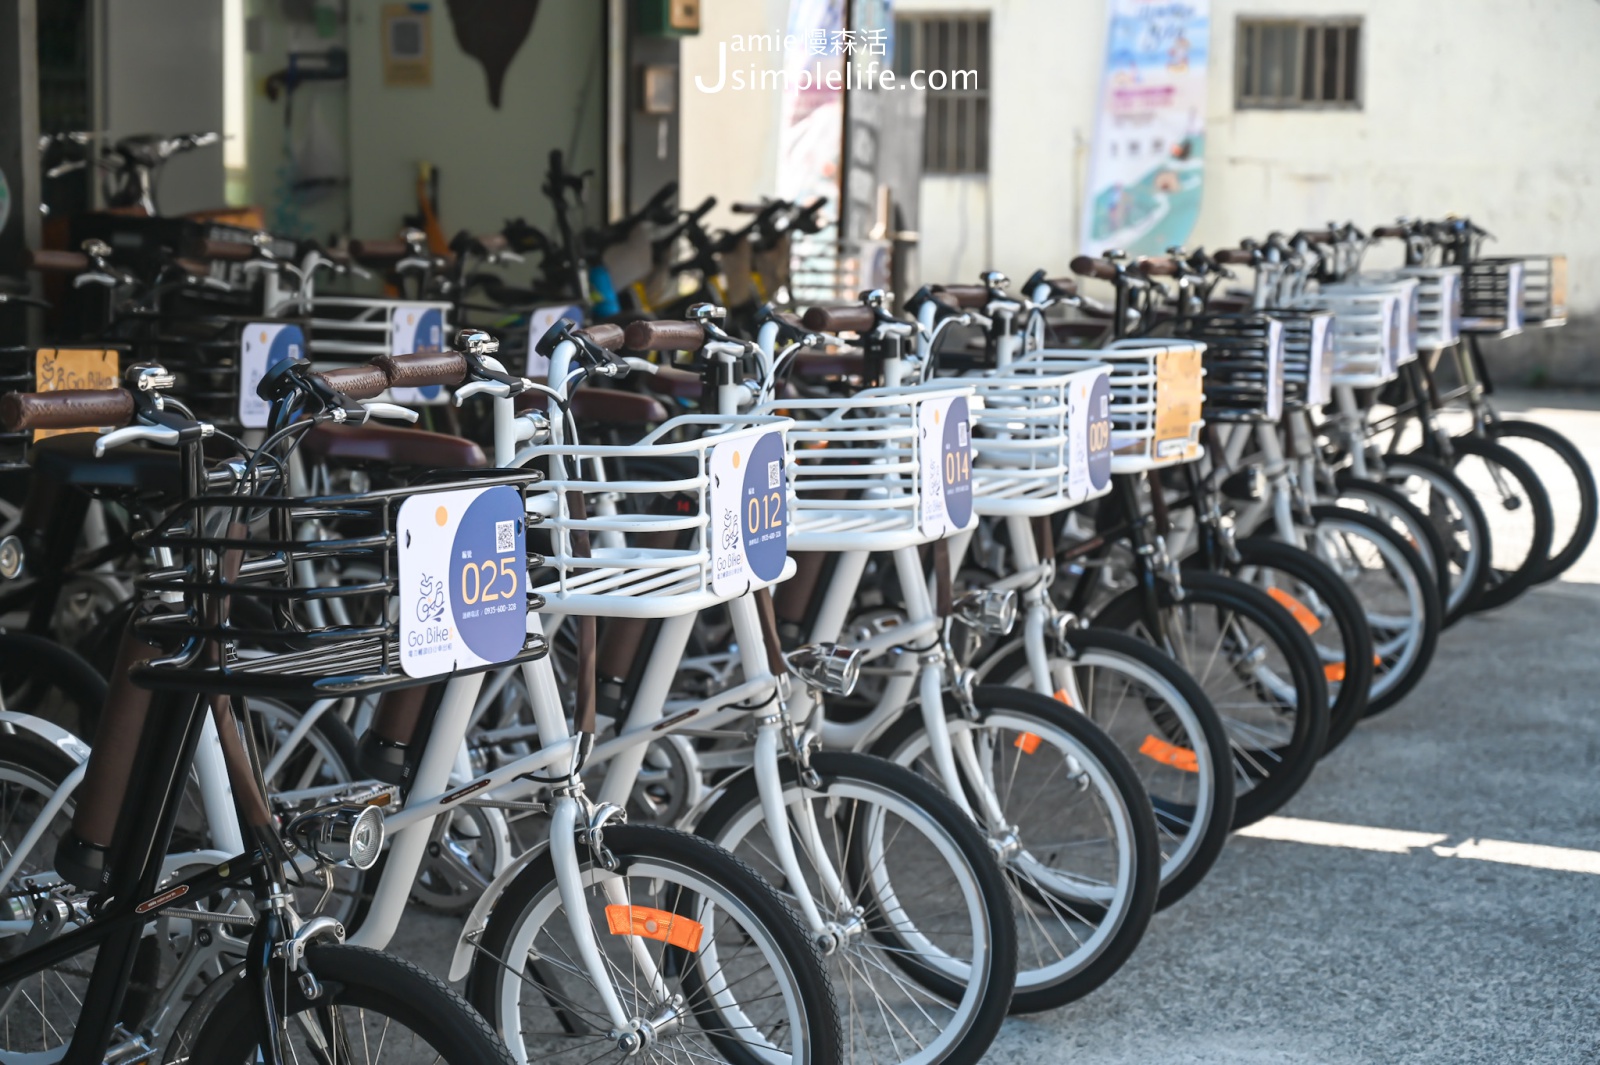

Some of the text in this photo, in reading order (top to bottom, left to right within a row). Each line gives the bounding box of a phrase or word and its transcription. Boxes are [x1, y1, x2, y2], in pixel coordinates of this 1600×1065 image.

[1089, 420, 1109, 452] 009
[946, 450, 970, 485] 014
[748, 492, 782, 534] 012
[717, 556, 726, 571] Go
[462, 557, 517, 605] 025
[408, 630, 424, 648] Go
[426, 626, 449, 644] Bike
